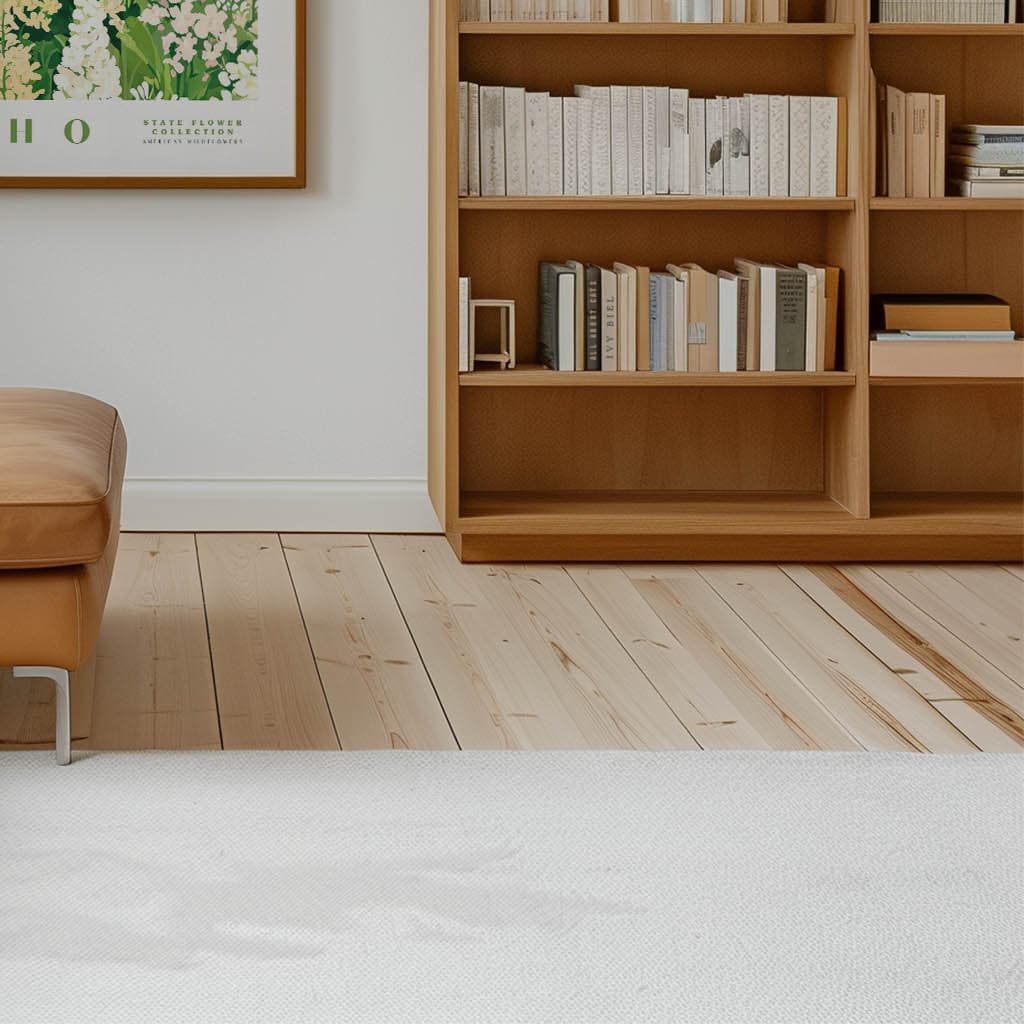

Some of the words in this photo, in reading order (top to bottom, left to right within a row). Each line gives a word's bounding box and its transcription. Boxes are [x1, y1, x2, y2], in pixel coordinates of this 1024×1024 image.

[589, 280, 598, 304] CATS
[606, 295, 615, 327] BIEL
[589, 344, 598, 361] ALL
[606, 335, 615, 359] IVY
